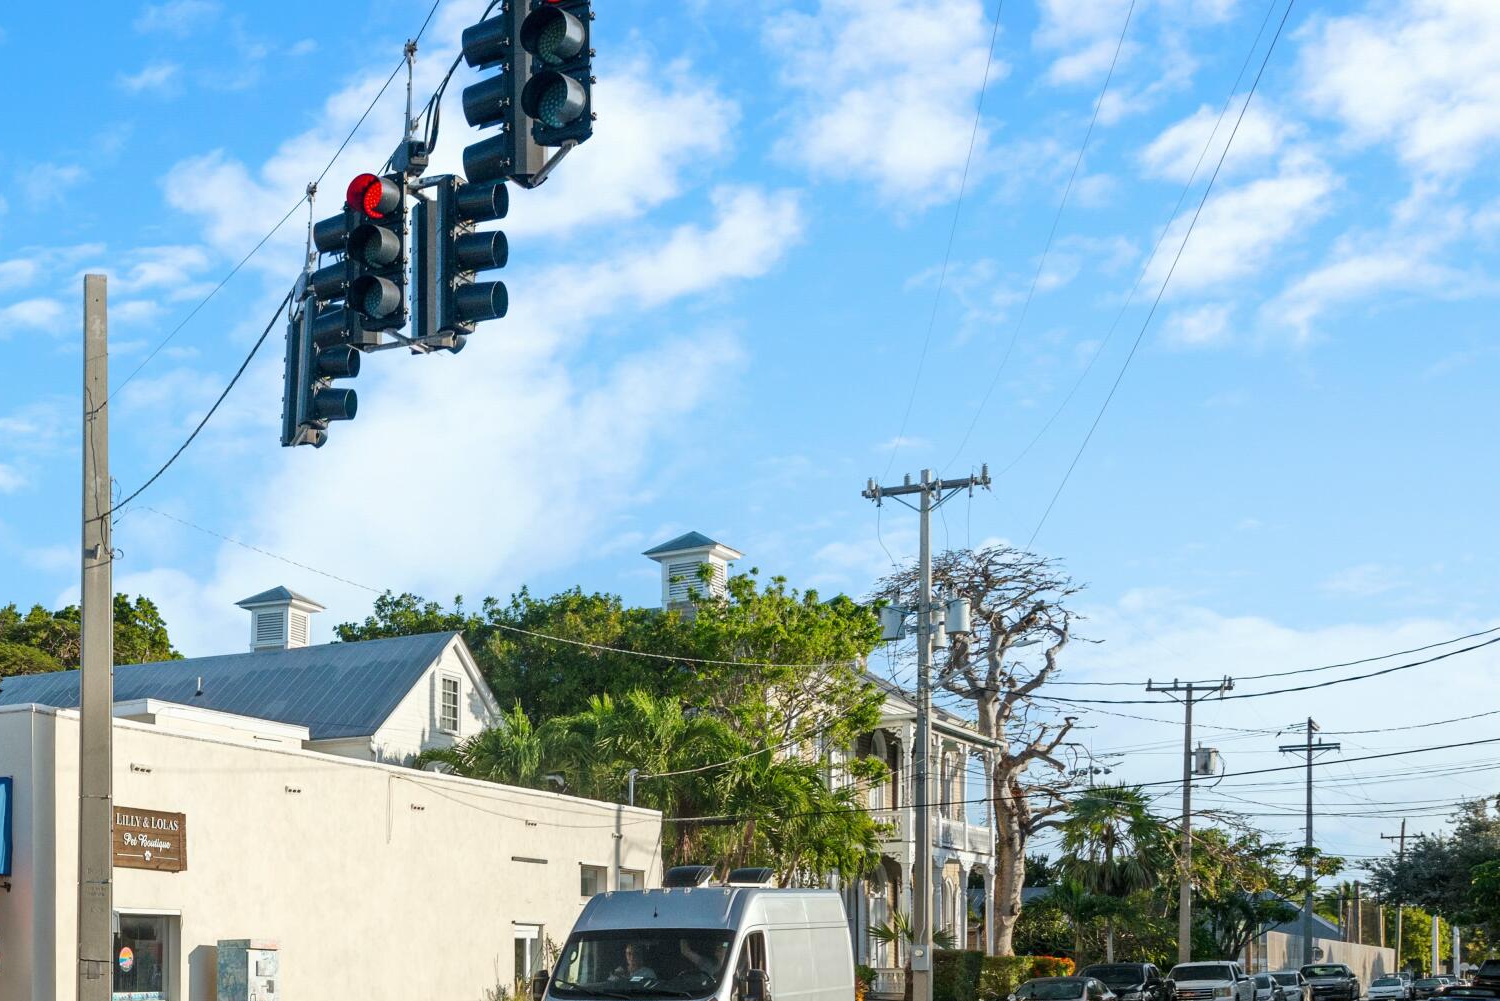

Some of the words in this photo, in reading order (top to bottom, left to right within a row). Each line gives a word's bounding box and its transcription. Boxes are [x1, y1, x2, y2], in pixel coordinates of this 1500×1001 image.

[116, 812, 141, 827] LILLY
[143, 817, 149, 828] &
[151, 816, 179, 831] LOLAS
[123, 832, 137, 846] Pet
[138, 833, 171, 852] Boutique
